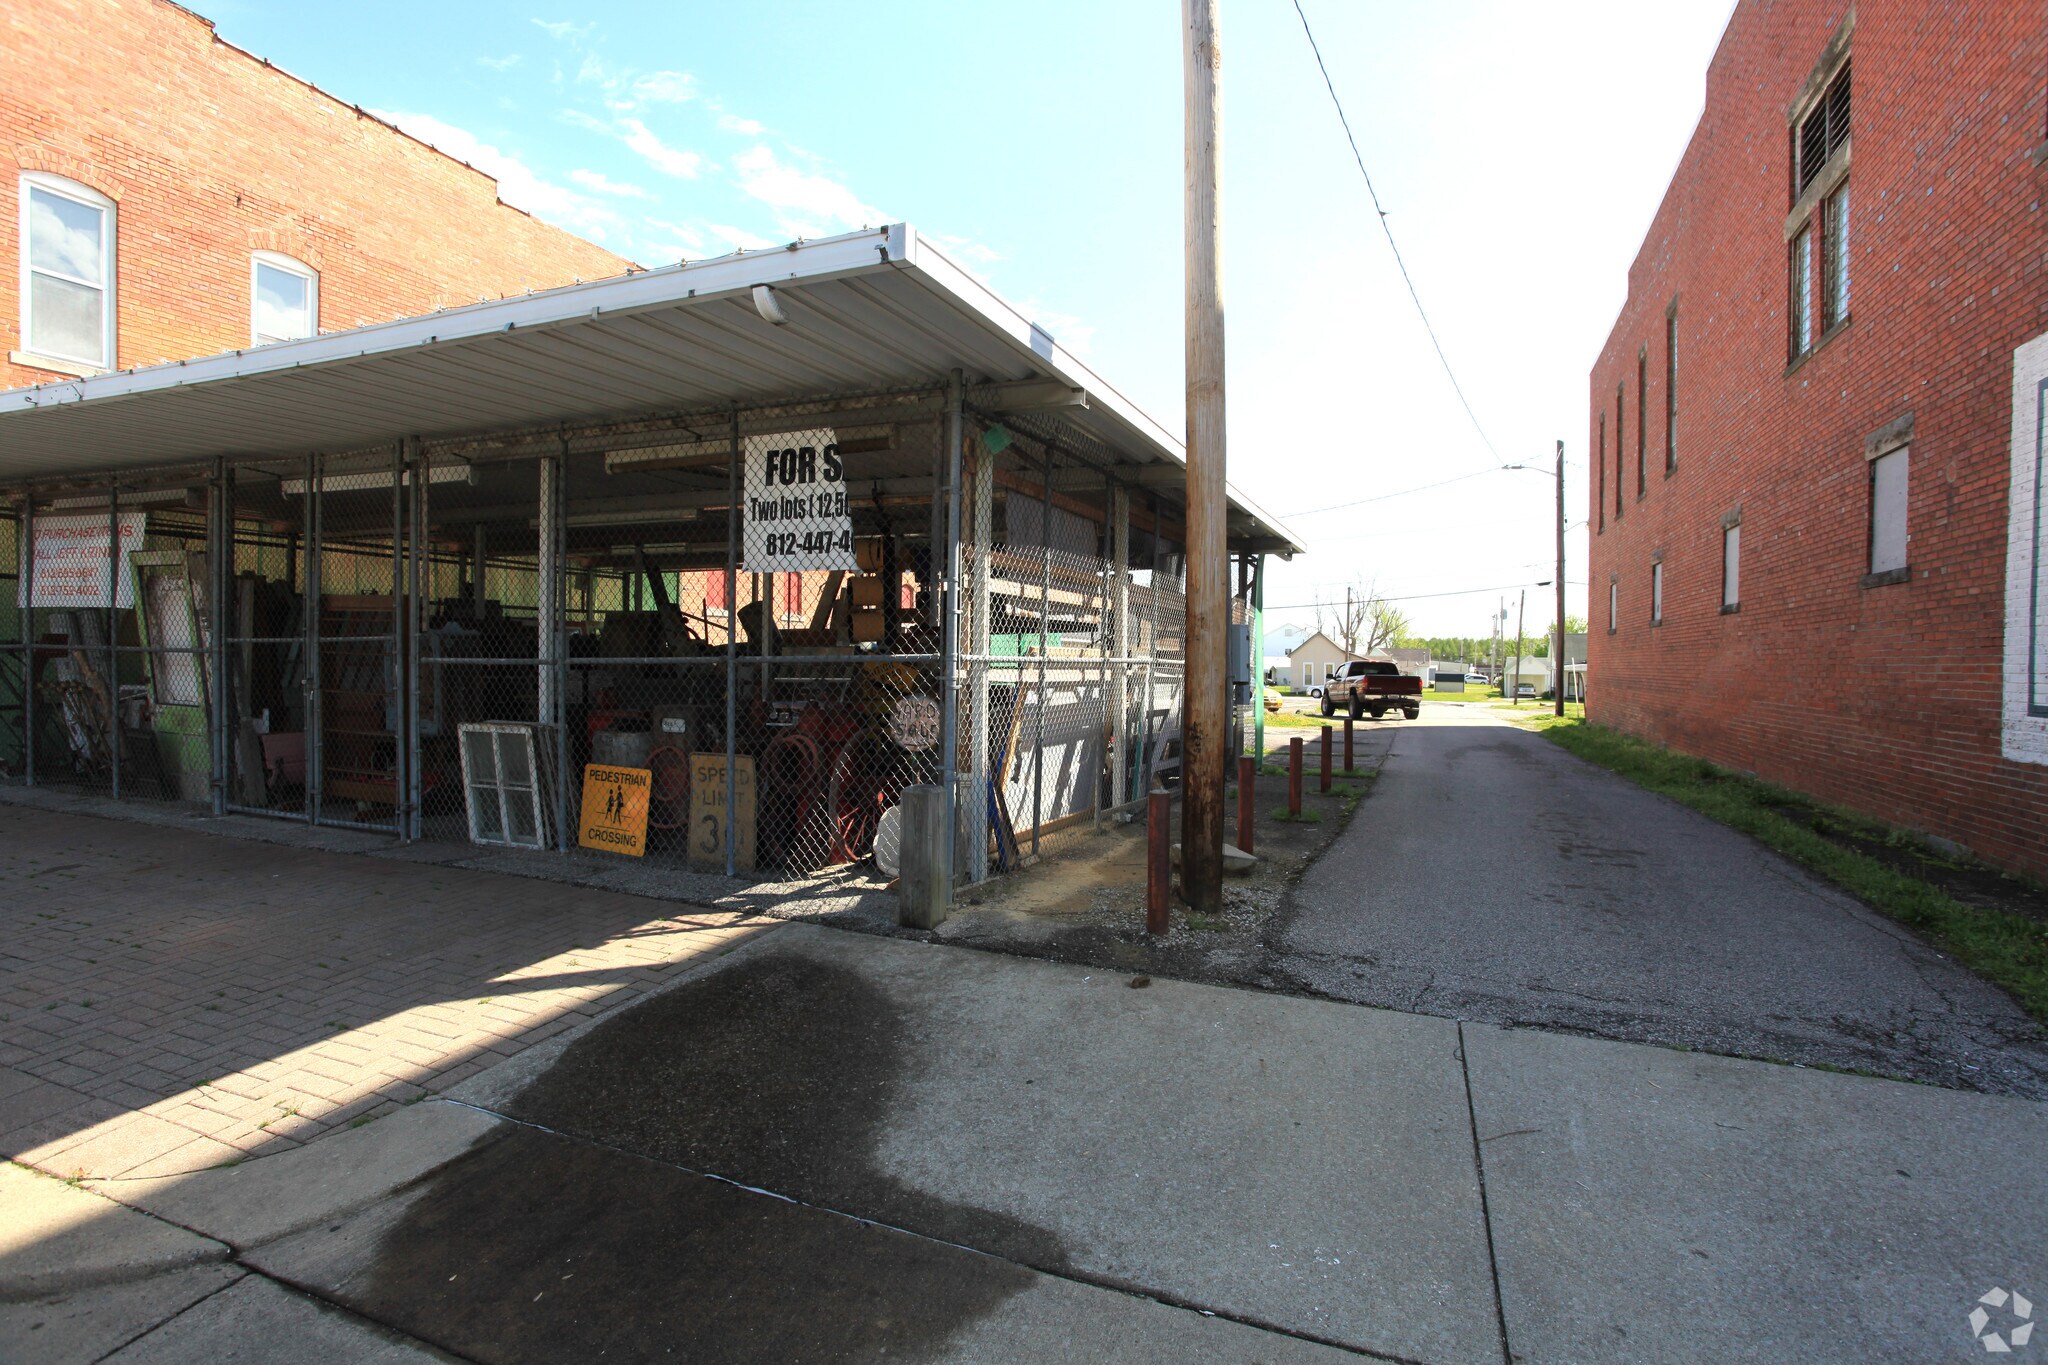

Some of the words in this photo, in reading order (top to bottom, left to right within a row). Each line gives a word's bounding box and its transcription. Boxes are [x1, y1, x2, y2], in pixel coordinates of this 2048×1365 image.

[765, 446, 816, 486] FOR
[823, 443, 844, 483] S
[750, 497, 778, 522] Two
[780, 495, 806, 520] lots
[42, 526, 97, 540] PURCHASE
[33, 548, 52, 560] ALL
[589, 769, 647, 787] PEDESTRIAN
[702, 789, 744, 808] LIMT
[587, 828, 637, 847] CROSSING
